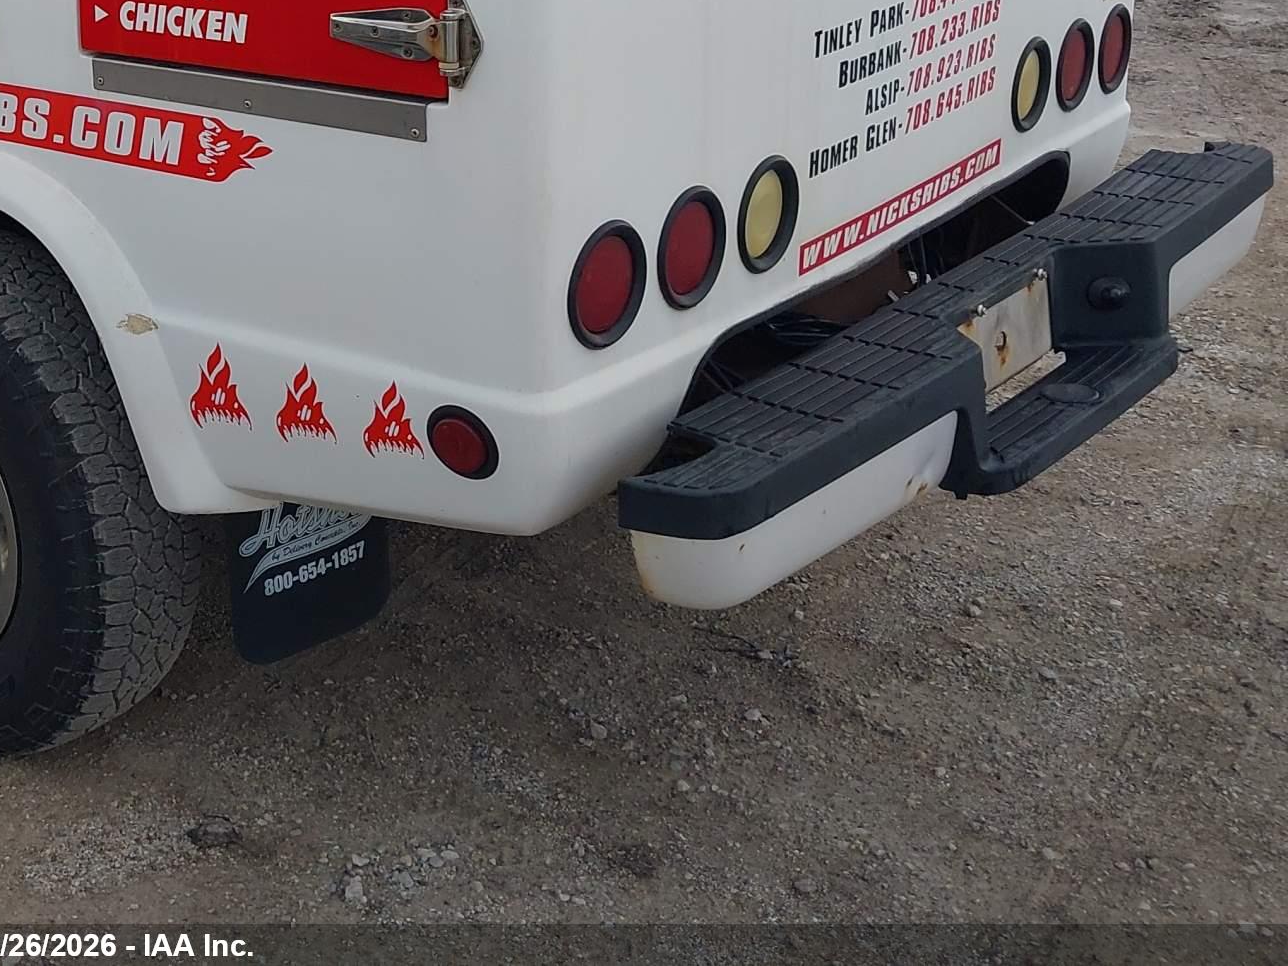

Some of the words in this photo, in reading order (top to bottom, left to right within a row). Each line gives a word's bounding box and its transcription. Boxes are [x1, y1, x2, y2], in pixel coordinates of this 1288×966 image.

[119, 0, 248, 44] CHICKEN
[814, 18, 863, 59] TINLEY
[809, 134, 859, 179] HOMER
[803, 145, 998, 268] WWW.NICKSRIBS.COM
[264, 540, 365, 596] 800-654-1857
